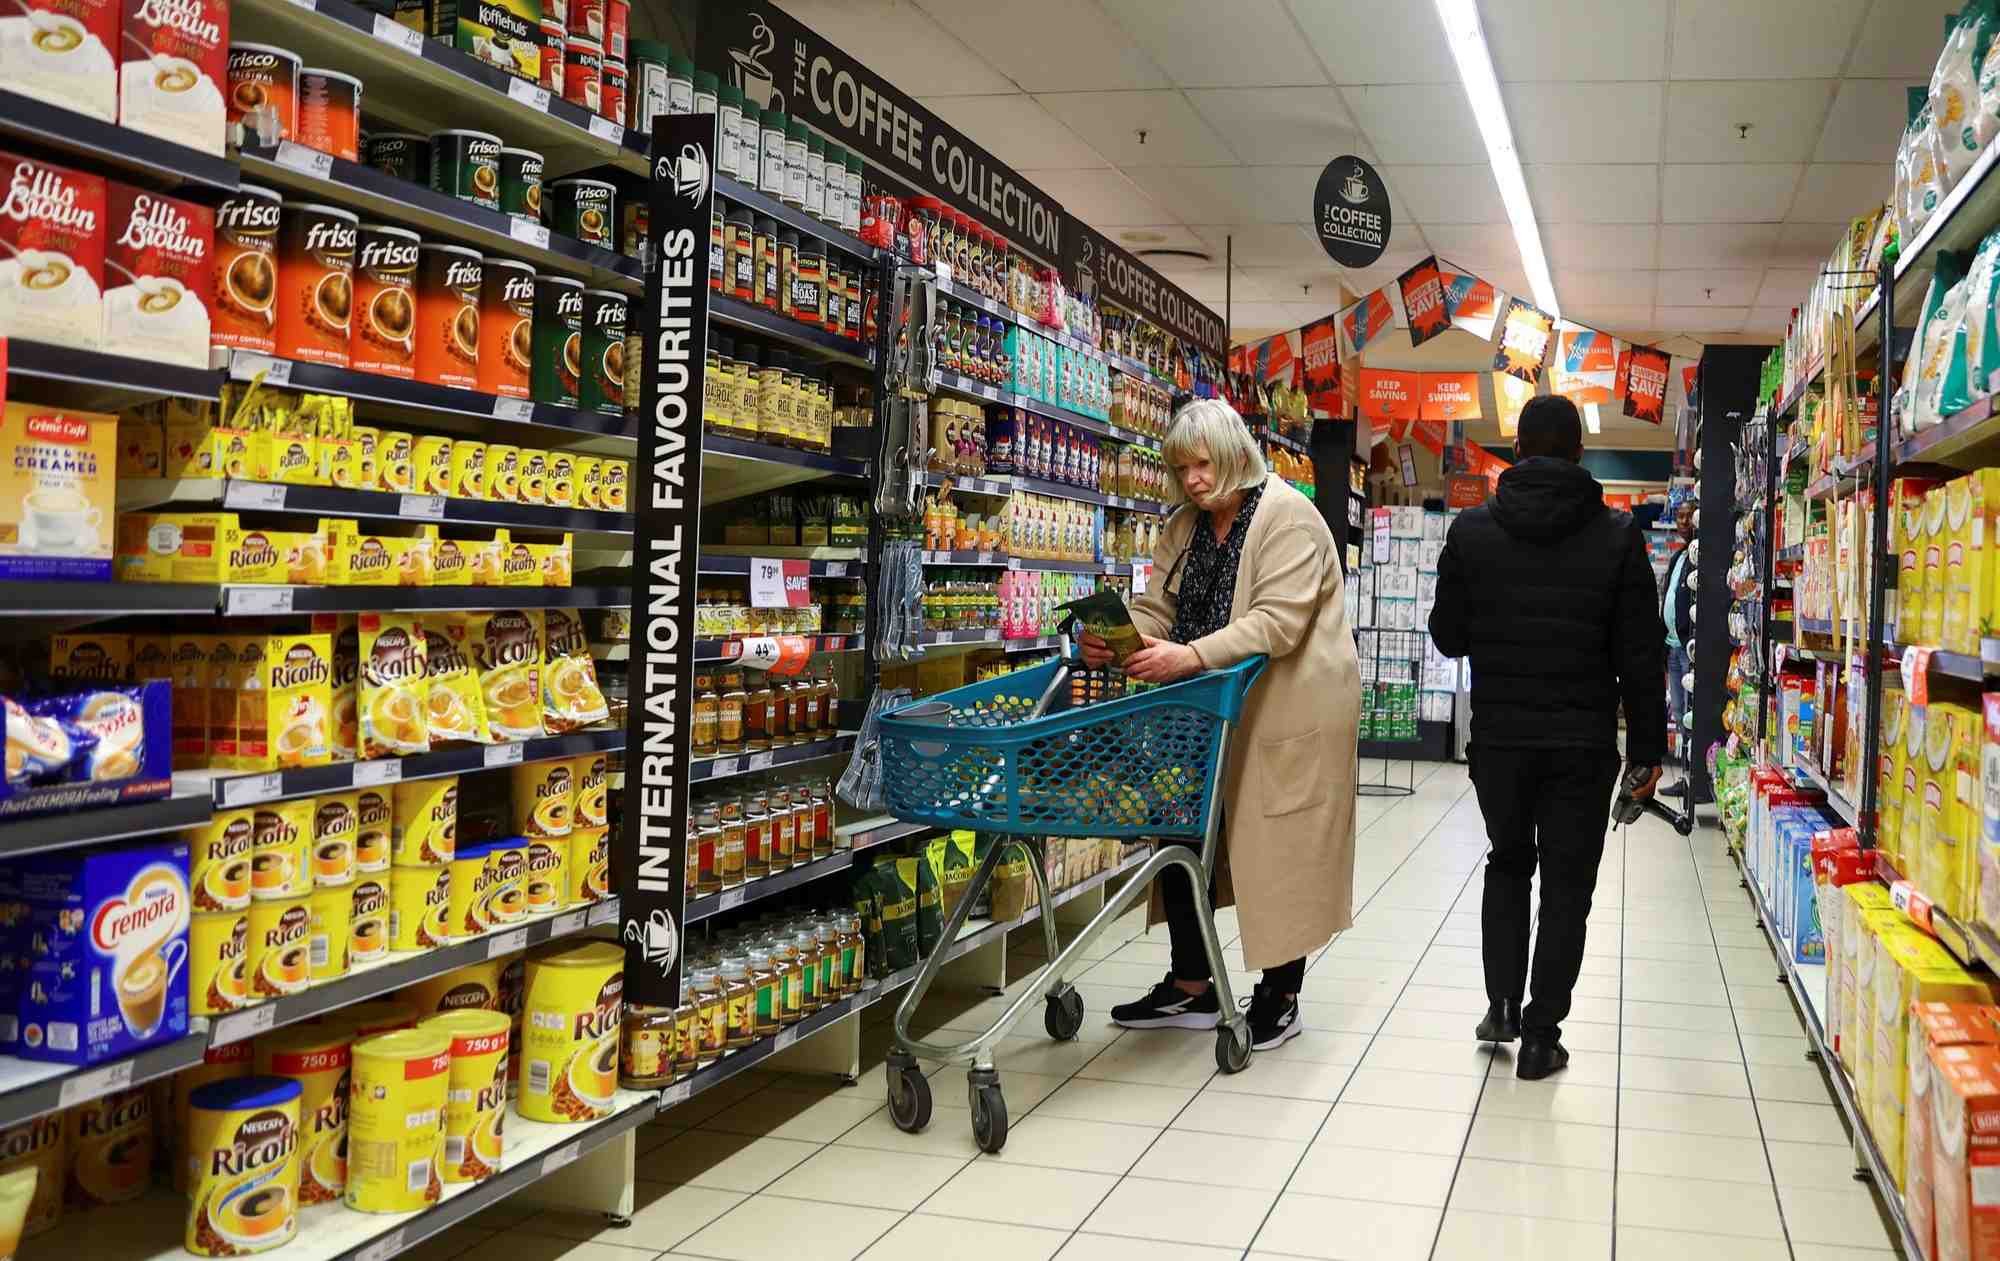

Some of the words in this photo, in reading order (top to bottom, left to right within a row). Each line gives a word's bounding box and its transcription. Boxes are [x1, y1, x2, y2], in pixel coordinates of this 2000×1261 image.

[793, 39, 807, 97] THE
[810, 55, 924, 171] COFFEE
[931, 134, 1061, 255] COLLECTION
[11, 162, 76, 206] Ellis
[575, 187, 610, 201] frisco
[0, 185, 96, 232] Brown
[130, 194, 187, 233] Ellis
[215, 198, 281, 229] frisco
[1330, 205, 1382, 231] COFFEE
[117, 215, 205, 257] Brown
[1323, 222, 1382, 244] COLLECTION
[1106, 252, 1157, 315] COFFEE
[1159, 287, 1223, 353] COLLECTION
[1408, 289, 1444, 321] SAVE
[652, 228, 696, 510] FAVOURITES
[1304, 350, 1337, 373] SAVE
[1369, 389, 1408, 401] SAVING
[1376, 379, 1401, 390] KEEP
[1437, 382, 1462, 393] KEEP
[1629, 379, 1665, 400] SAVE
[1428, 391, 1472, 403] SWIPING
[14, 456, 98, 475] CREAMER
[229, 544, 280, 568] Ricoffy
[350, 552, 392, 571] Ricoffy
[503, 556, 537, 574] Ricoffy
[784, 575, 808, 592] SAVE
[271, 656, 330, 689] Ricoffy
[637, 524, 683, 892] INTERNATIONAL
[92, 892, 176, 951] Cremora
[466, 1038, 489, 1051] 750
[302, 1053, 327, 1067] 750
